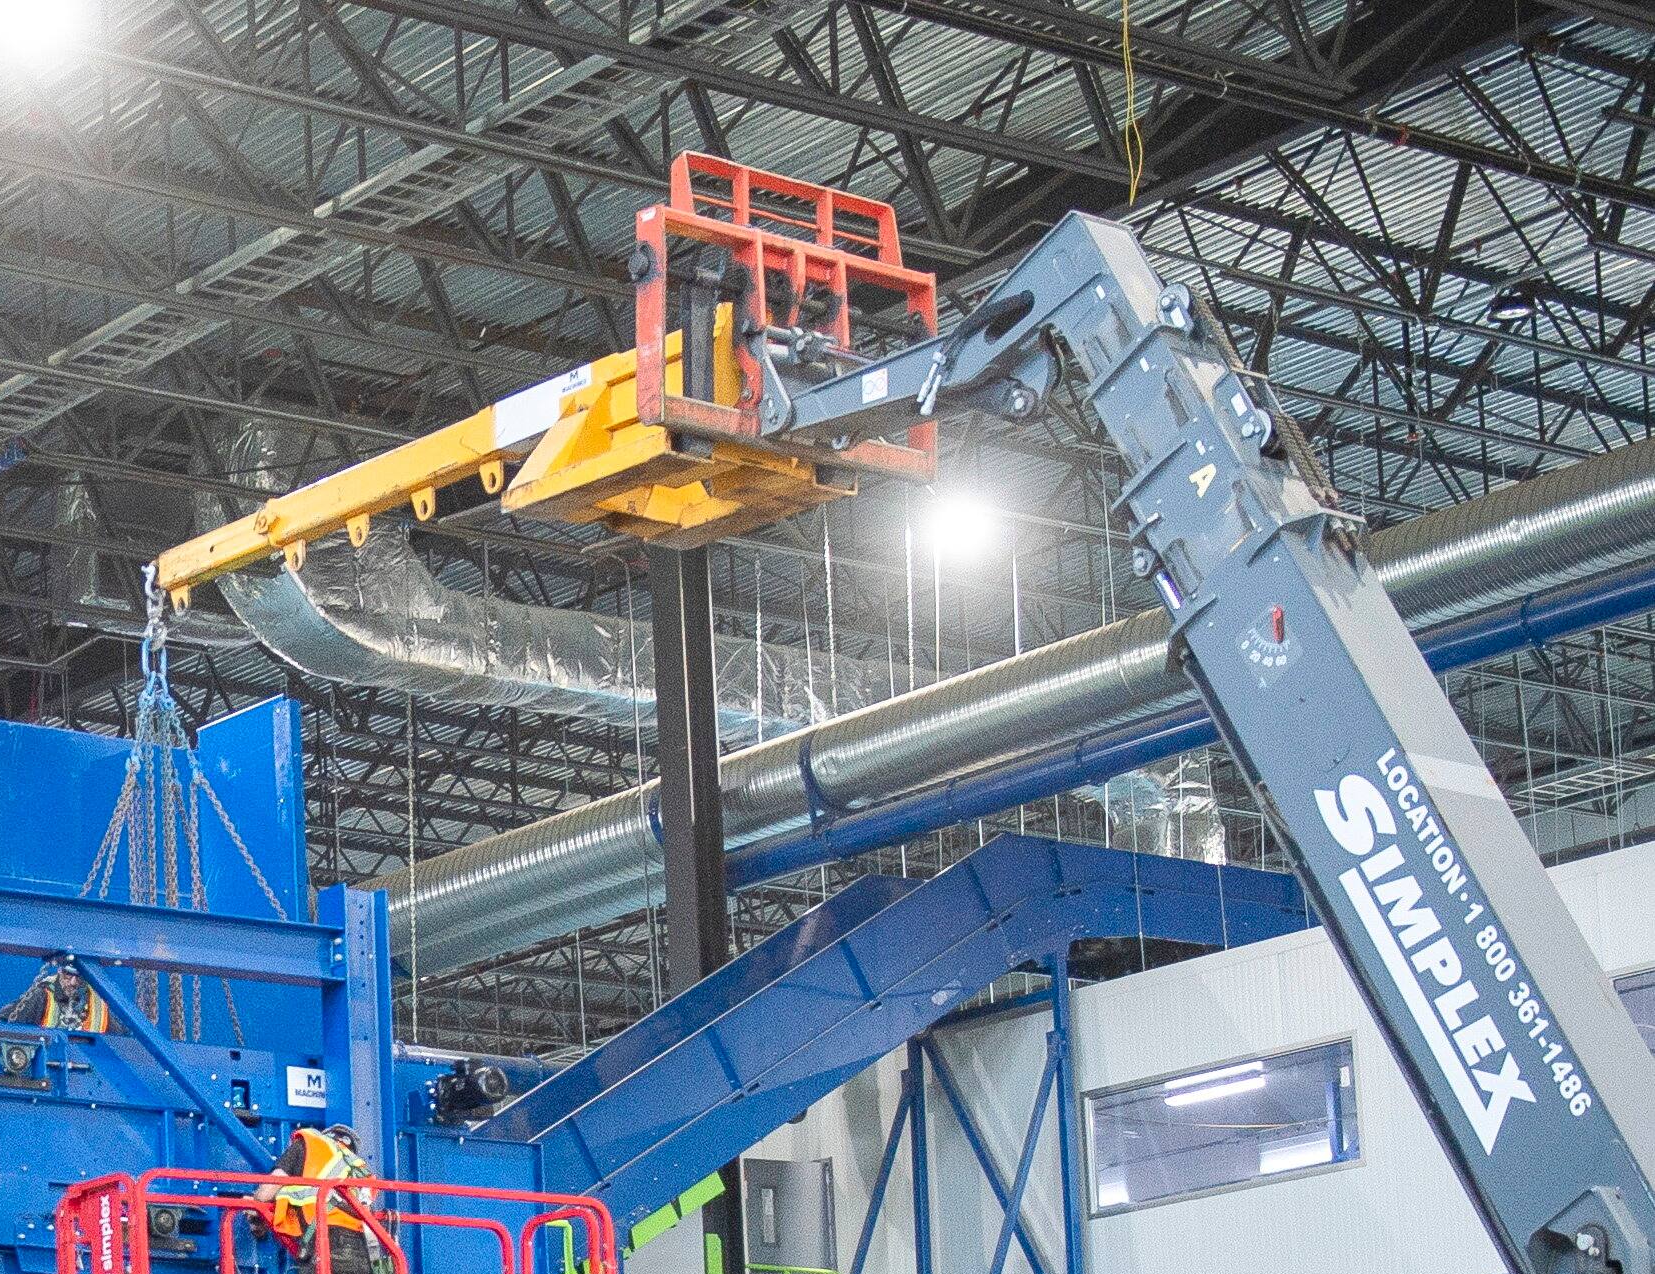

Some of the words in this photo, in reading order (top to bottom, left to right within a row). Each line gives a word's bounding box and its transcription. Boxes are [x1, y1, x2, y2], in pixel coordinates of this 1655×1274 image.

[1188, 463, 1216, 498] A
[1313, 773, 1538, 1130] SIMPLEX
[1376, 747, 1468, 895] LOCATION
[1462, 902, 1485, 924] 1
[1476, 925, 1518, 983] 800
[1508, 981, 1593, 1118] 361-1486
[295, 1089, 326, 1099] MACHIN
[307, 1074, 322, 1089] M
[100, 1194, 114, 1271] simplex
